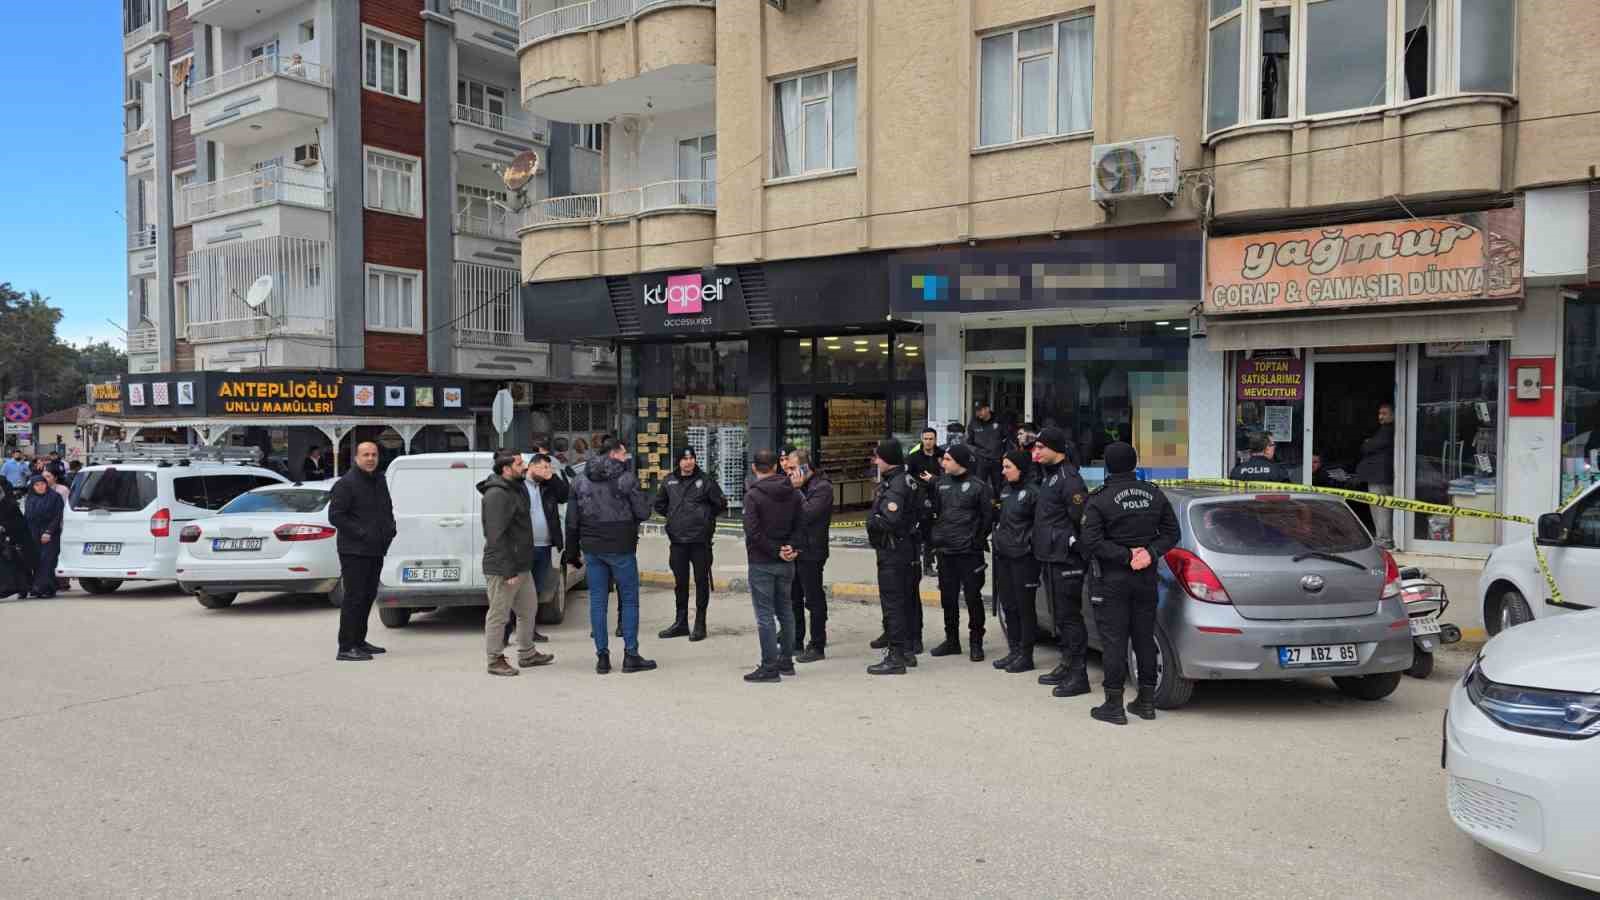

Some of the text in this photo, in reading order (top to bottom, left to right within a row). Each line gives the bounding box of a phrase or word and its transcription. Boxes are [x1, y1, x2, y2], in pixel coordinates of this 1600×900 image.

[1242, 225, 1477, 280] yağmur
[1212, 282, 1280, 310] ÇORAP
[1286, 283, 1302, 304] &
[1306, 271, 1403, 305] ÇAMAŞIR
[1255, 360, 1289, 371] TOPTAN
[218, 379, 339, 399] ANTEPLİOĞLU
[1243, 387, 1297, 397] MEVCUTTUR
[225, 399, 334, 414] UNLU MAMÜLLERİ
[1288, 645, 1354, 662] 27 ABZ 85
